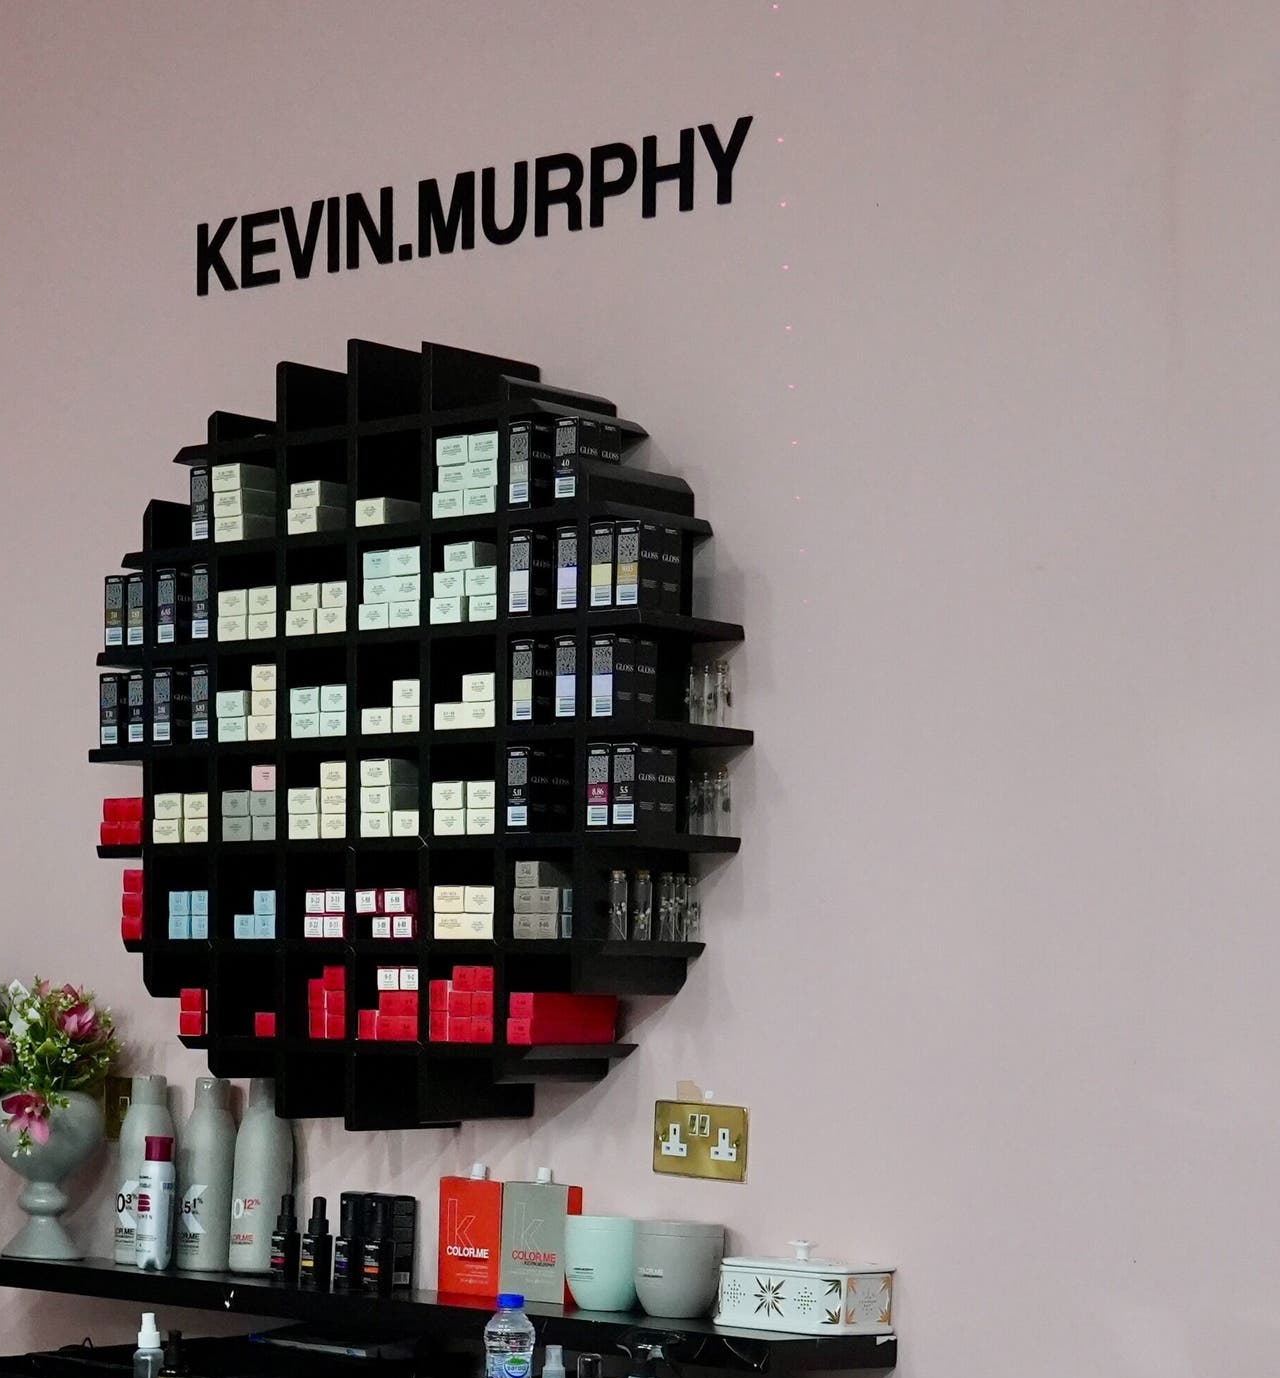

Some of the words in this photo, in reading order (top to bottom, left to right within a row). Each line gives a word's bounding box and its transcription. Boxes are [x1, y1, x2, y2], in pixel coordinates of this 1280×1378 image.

[196, 115, 754, 296] KEVIN.MURPHY
[579, 446, 599, 457] GLOSS
[601, 450, 620, 461] GLOSS
[640, 550, 660, 560] GLOSS
[661, 553, 681, 564] GLOSS
[615, 663, 635, 673] GLOSS
[637, 664, 657, 674] GLOSS
[637, 773, 657, 783] GLOSS
[658, 774, 677, 784] GLOSS
[446, 1245, 490, 1259] COLOR.ME
[512, 1250, 557, 1264] COLOR.ME
